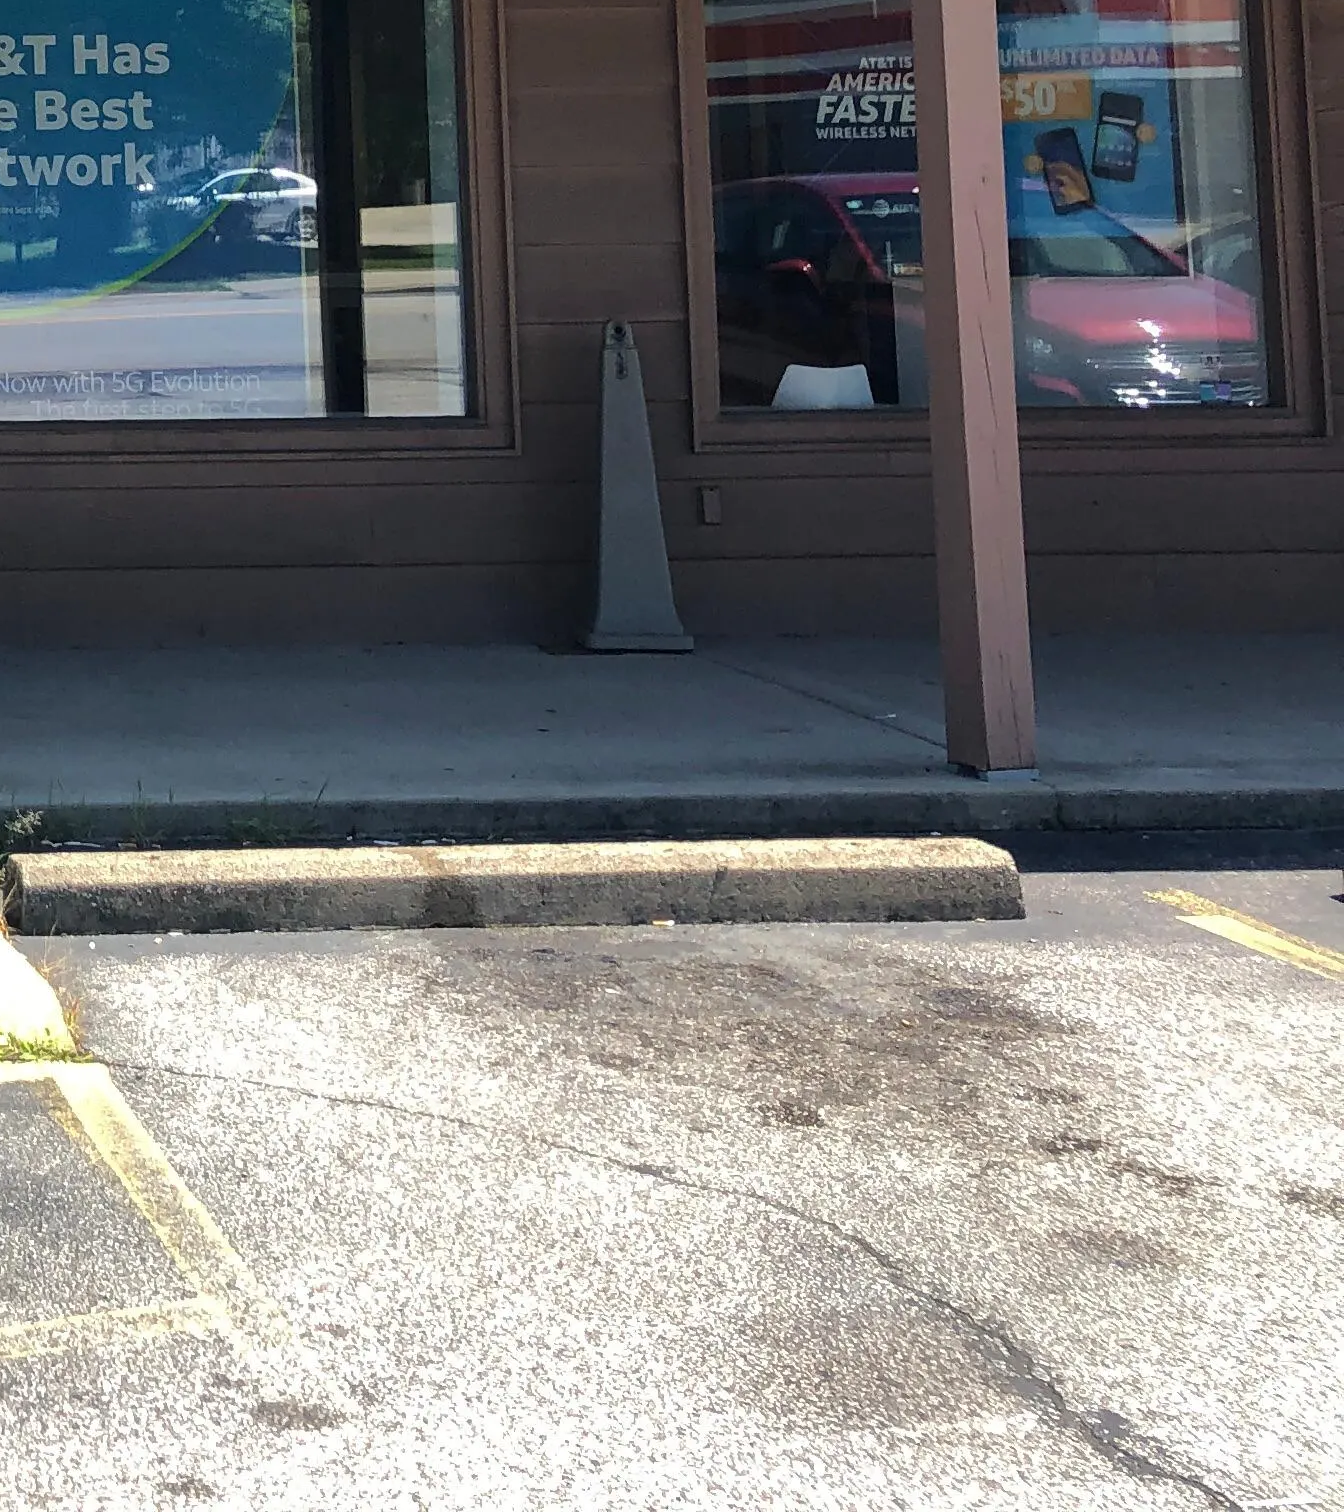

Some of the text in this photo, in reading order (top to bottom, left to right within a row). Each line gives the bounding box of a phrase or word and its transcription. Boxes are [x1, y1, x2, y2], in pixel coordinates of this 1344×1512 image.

[73, 35, 170, 75] Has
[859, 56, 897, 69] AT&T
[1000, 46, 1160, 67] UNLIMITED DATA
[825, 72, 915, 92] AMERIC
[35, 90, 154, 131] Best
[816, 94, 916, 124] FASTE
[816, 126, 887, 139] WIRELESS
[53, 370, 105, 393] with
[112, 371, 144, 393] 5G
[151, 369, 261, 393] Evolution
[82, 399, 128, 417] first
[198, 400, 223, 416] to
[231, 398, 261, 416] 5G
